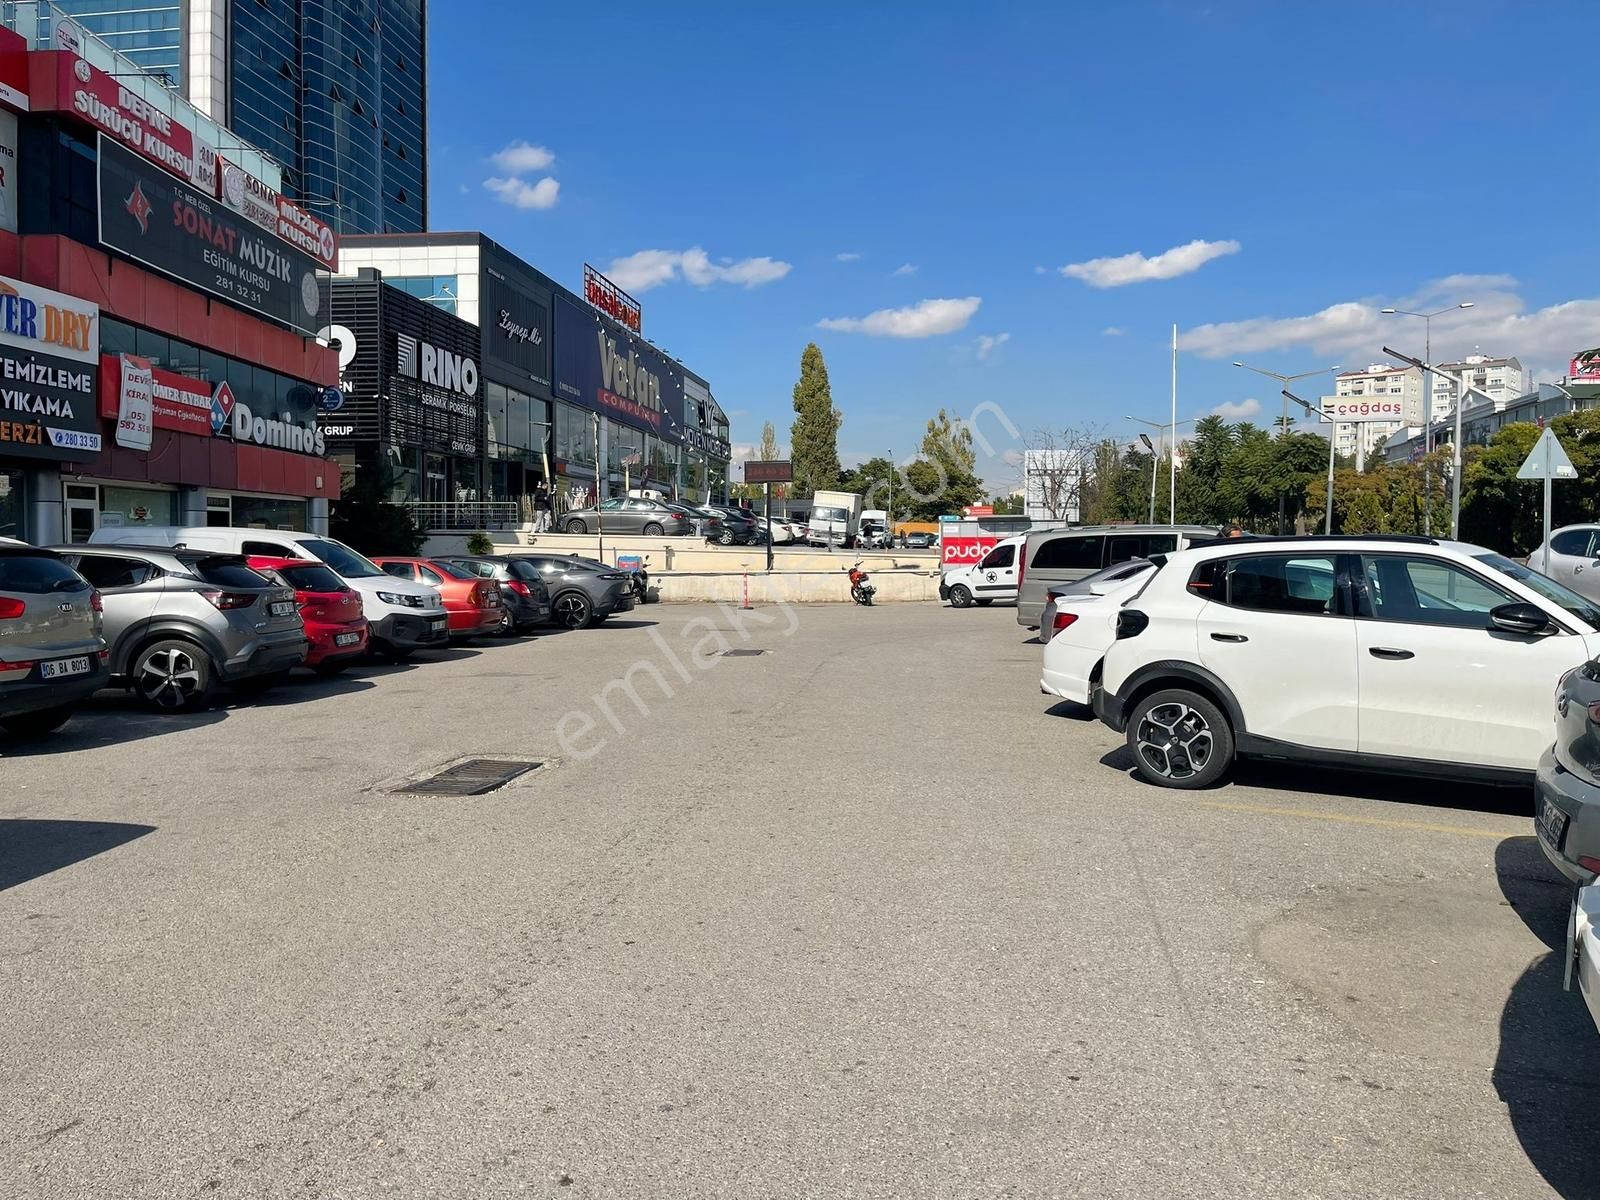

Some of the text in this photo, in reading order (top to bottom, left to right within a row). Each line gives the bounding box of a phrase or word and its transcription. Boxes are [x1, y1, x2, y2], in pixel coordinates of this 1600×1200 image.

[118, 86, 171, 137] DEFNE
[74, 90, 193, 178] SÜRÜCÜ KURSU
[185, 193, 197, 206] MEB
[197, 197, 212, 215] ÖZEL
[244, 173, 279, 206] SONAT
[280, 200, 320, 238] MÜZİK
[172, 200, 236, 254] SONAT
[239, 235, 291, 284] MÜZİK
[280, 220, 320, 256] KURSU
[203, 248, 270, 292] EĞİTİM KURSU
[215, 274, 261, 304] 281 32 31
[0, 294, 95, 351] ER DRY
[421, 341, 478, 397] RINO
[0, 388, 74, 419] YIKAMA
[152, 379, 180, 403] ÖMER
[1338, 402, 1401, 416] çağdaş
[0, 419, 41, 445] ERZİ
[65, 432, 98, 449] 280 33 50
[232, 402, 326, 456] Domino's
[324, 425, 354, 436] GRUP
[61, 603, 73, 612] KIA
[46, 663, 55, 676] 06
[71, 658, 87, 672] 8013
